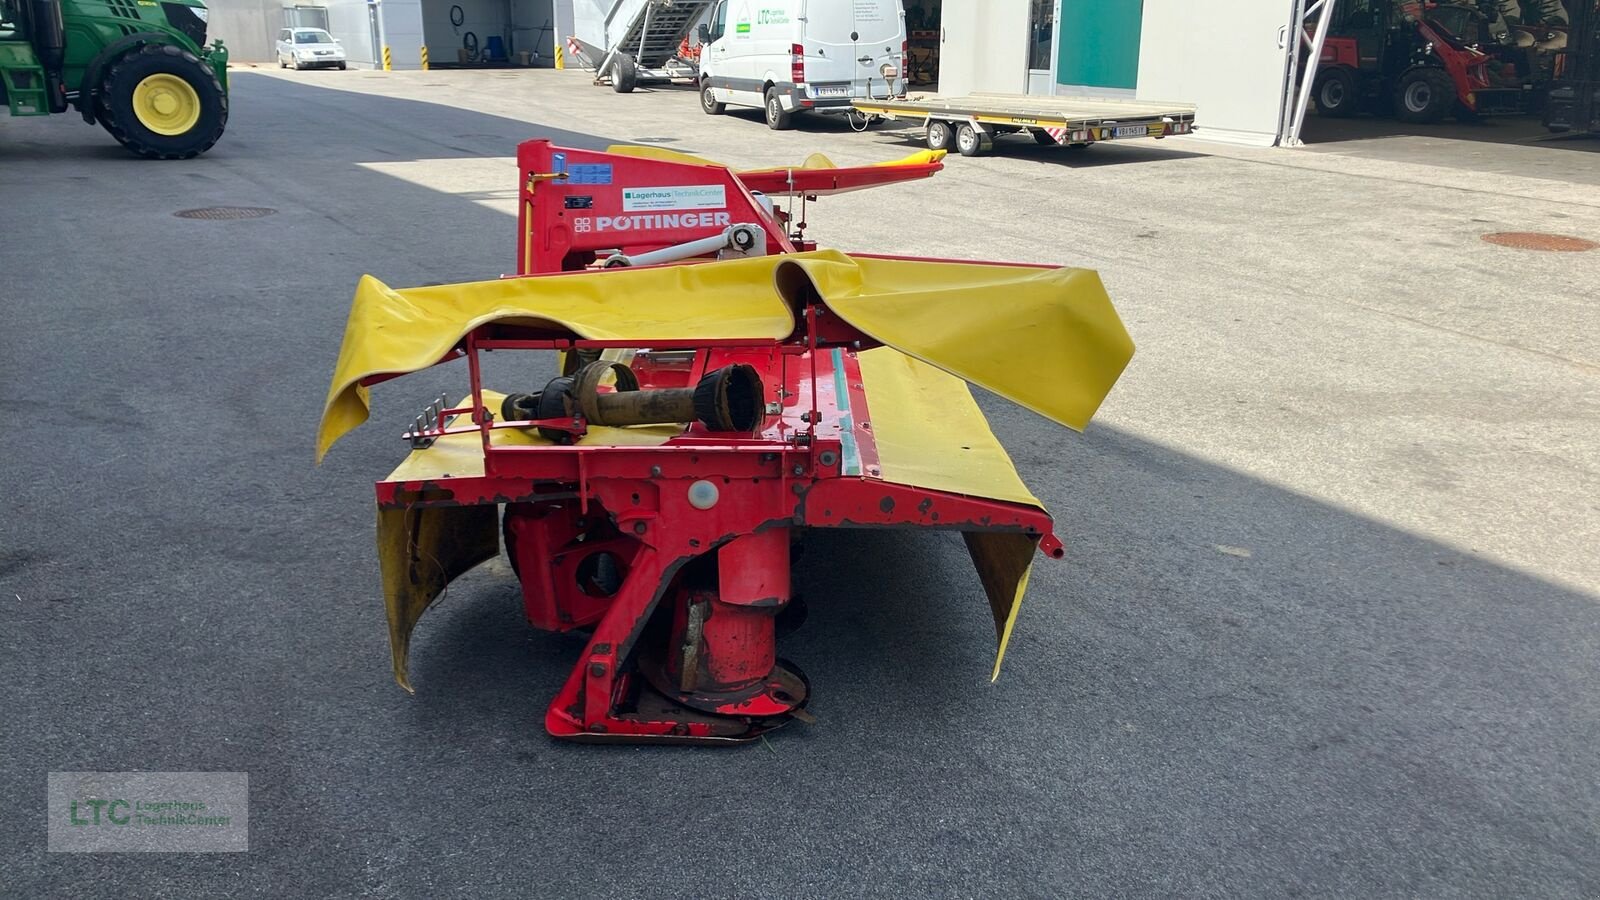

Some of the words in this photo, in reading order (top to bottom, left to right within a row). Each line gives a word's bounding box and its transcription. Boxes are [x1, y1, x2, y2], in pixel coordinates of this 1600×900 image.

[757, 9, 770, 25] LTC
[632, 190, 672, 201] Lagerhaus
[596, 211, 731, 232] PÖTTINGER
